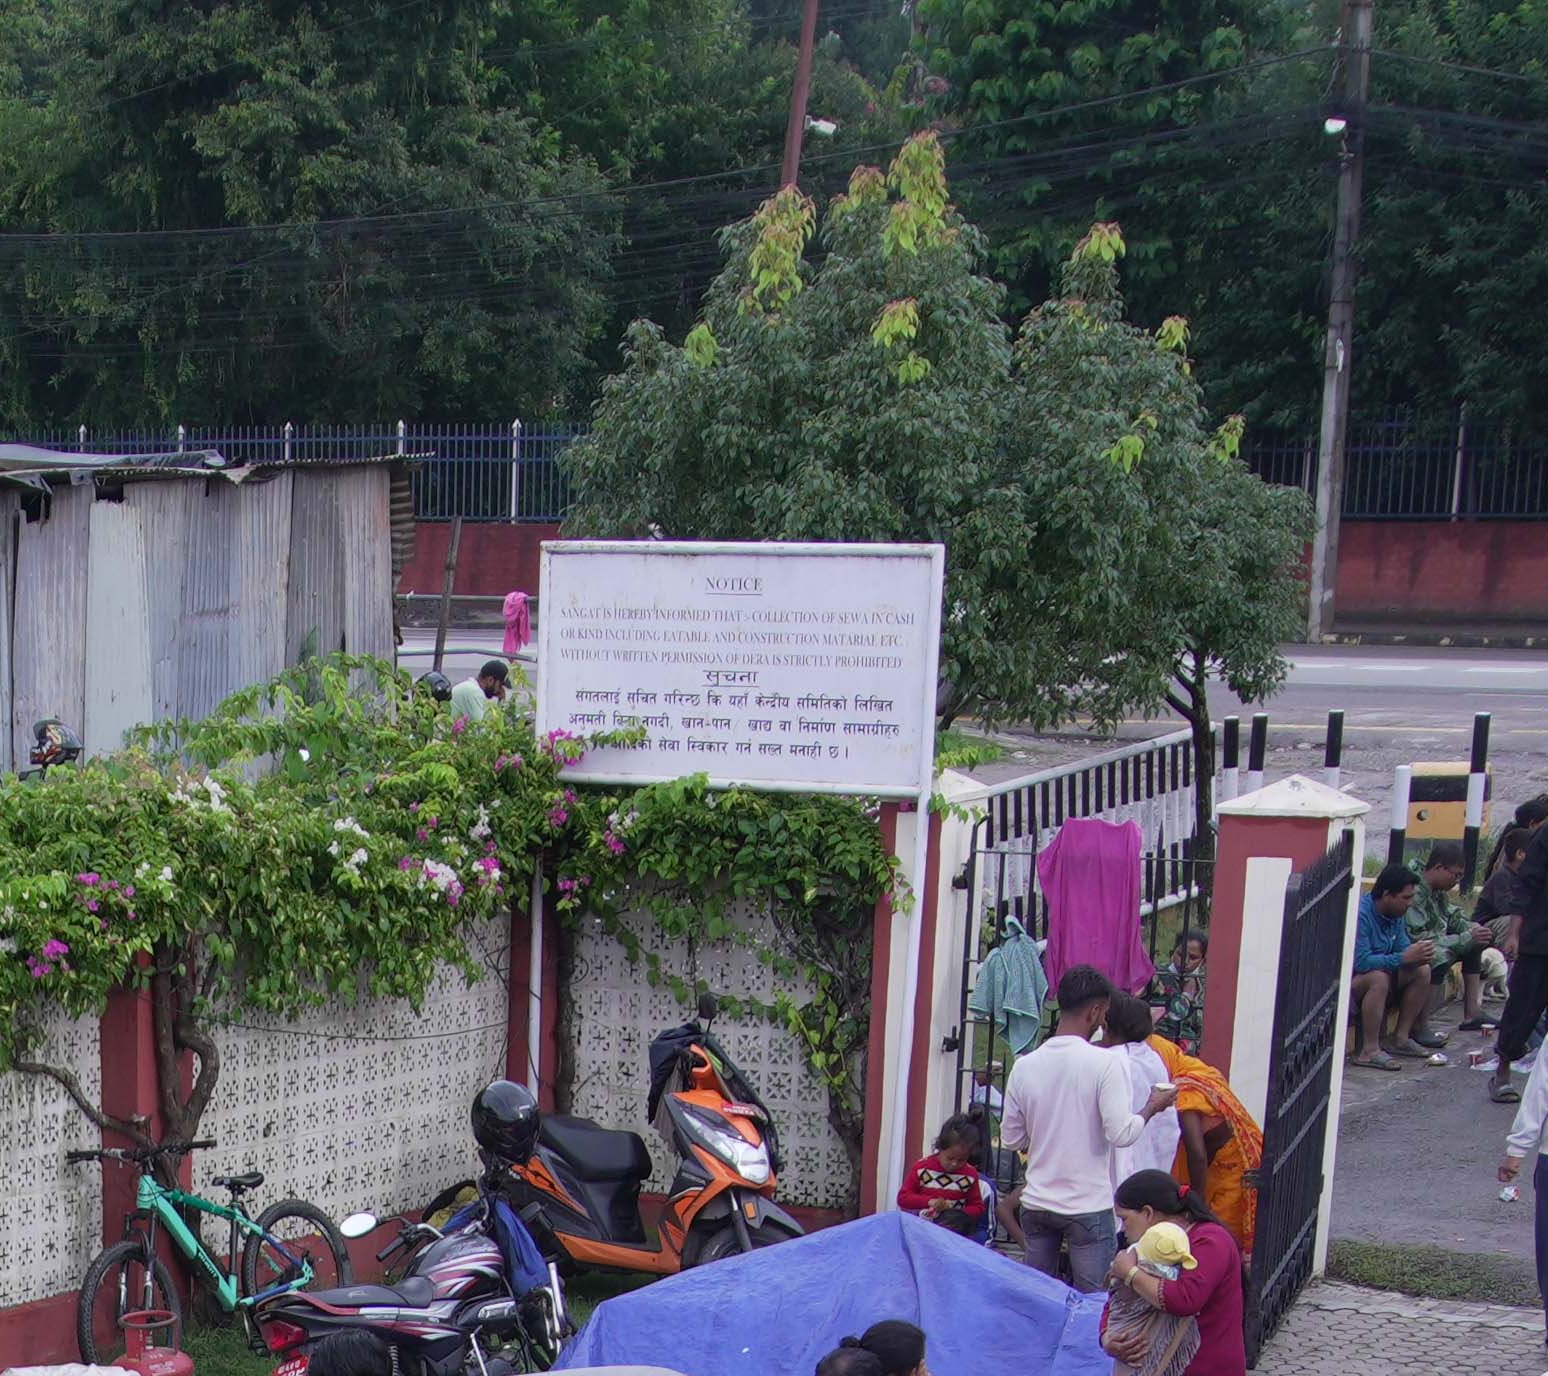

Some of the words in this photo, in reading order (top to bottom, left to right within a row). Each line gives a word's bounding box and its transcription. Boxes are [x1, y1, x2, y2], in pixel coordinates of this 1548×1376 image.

[706, 577, 762, 591] NOTICE
[560, 608, 600, 619] SANGAT
[604, 608, 612, 619] IS
[614, 608, 653, 620] HEREBY
[655, 609, 710, 621] INFORMED
[713, 610, 741, 622] THAT
[752, 611, 819, 623] COLLECTION
[822, 612, 834, 623] OF
[835, 612, 868, 624] SEWA
[872, 613, 882, 624] IN
[886, 613, 914, 625] CASH
[560, 628, 575, 639] OR
[577, 629, 603, 640] KIND
[605, 630, 660, 641] INCLUDING
[664, 631, 712, 643] EATABLE
[714, 632, 736, 643] AND
[738, 632, 819, 645] CONSTRUCTION
[823, 634, 876, 646] MATARIAL
[560, 649, 608, 661] WITHOUT
[613, 650, 657, 662] WRITTEN
[661, 651, 722, 664] PERMISSION
[726, 653, 740, 664] OF
[742, 654, 770, 665] DERA
[773, 655, 782, 665] IS
[784, 655, 832, 667] STRICTLY
[835, 656, 902, 669] PROHIBITED
[707, 690, 721, 707] कि
[796, 693, 848, 711] समितिको
[854, 694, 894, 712] लिखित
[779, 720, 791, 732] वा
[799, 716, 836, 735] निर्माण
[659, 736, 680, 752] सेवा
[687, 736, 728, 755] स्विकार
[789, 741, 822, 760] मनाही
[828, 746, 840, 759] छ
